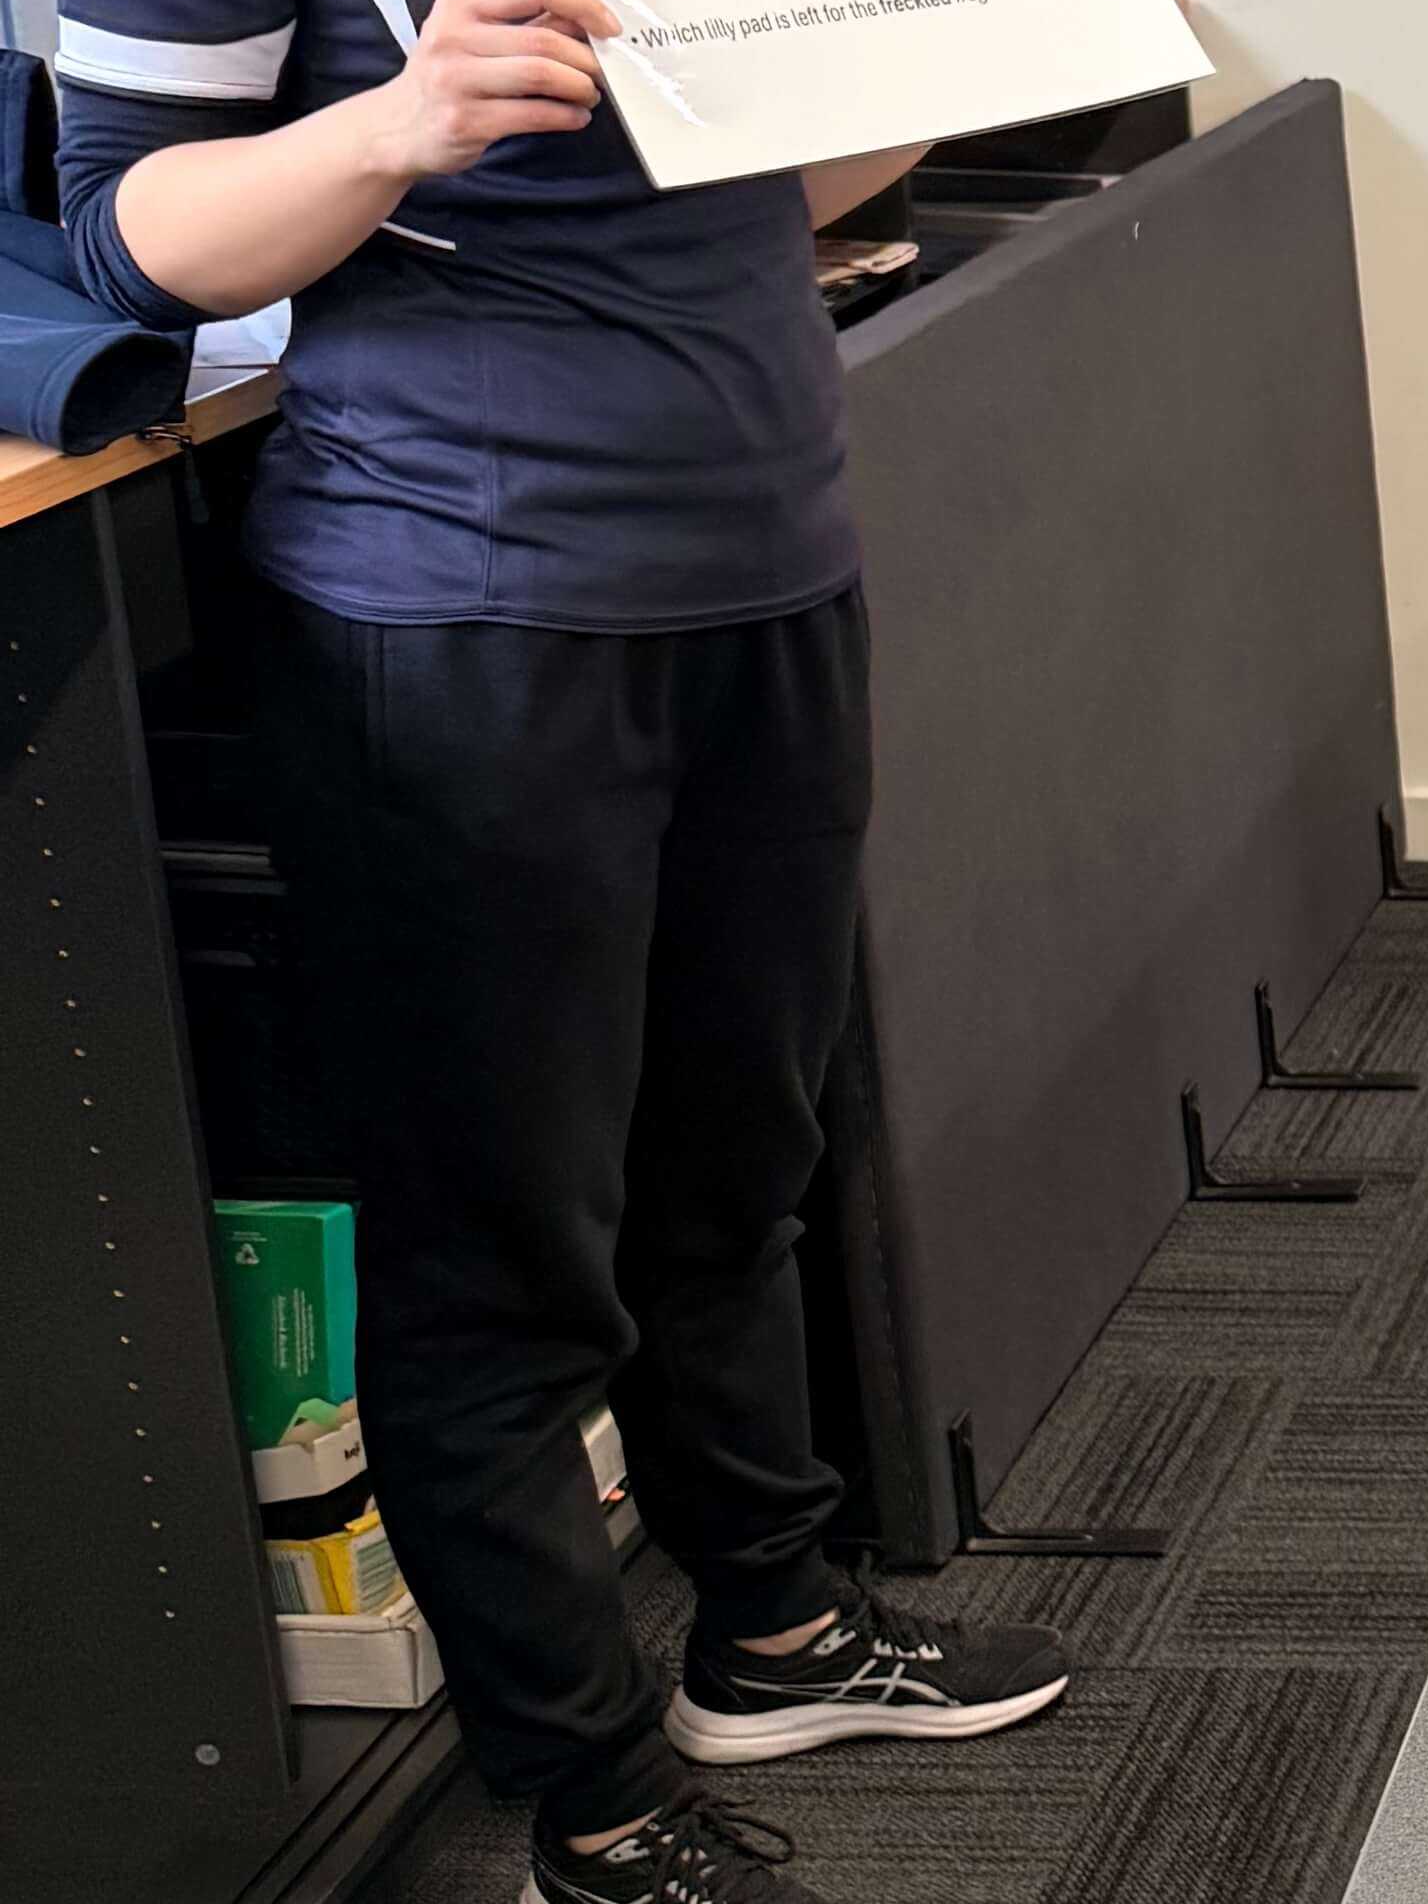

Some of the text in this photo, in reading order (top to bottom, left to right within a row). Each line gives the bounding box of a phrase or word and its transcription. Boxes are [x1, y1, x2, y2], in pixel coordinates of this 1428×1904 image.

[704, 16, 736, 41] lilly
[739, 10, 773, 36] pad
[774, 10, 791, 30] is
[791, 5, 823, 27] left
[823, 3, 848, 24] for
[849, 0, 878, 21] the
